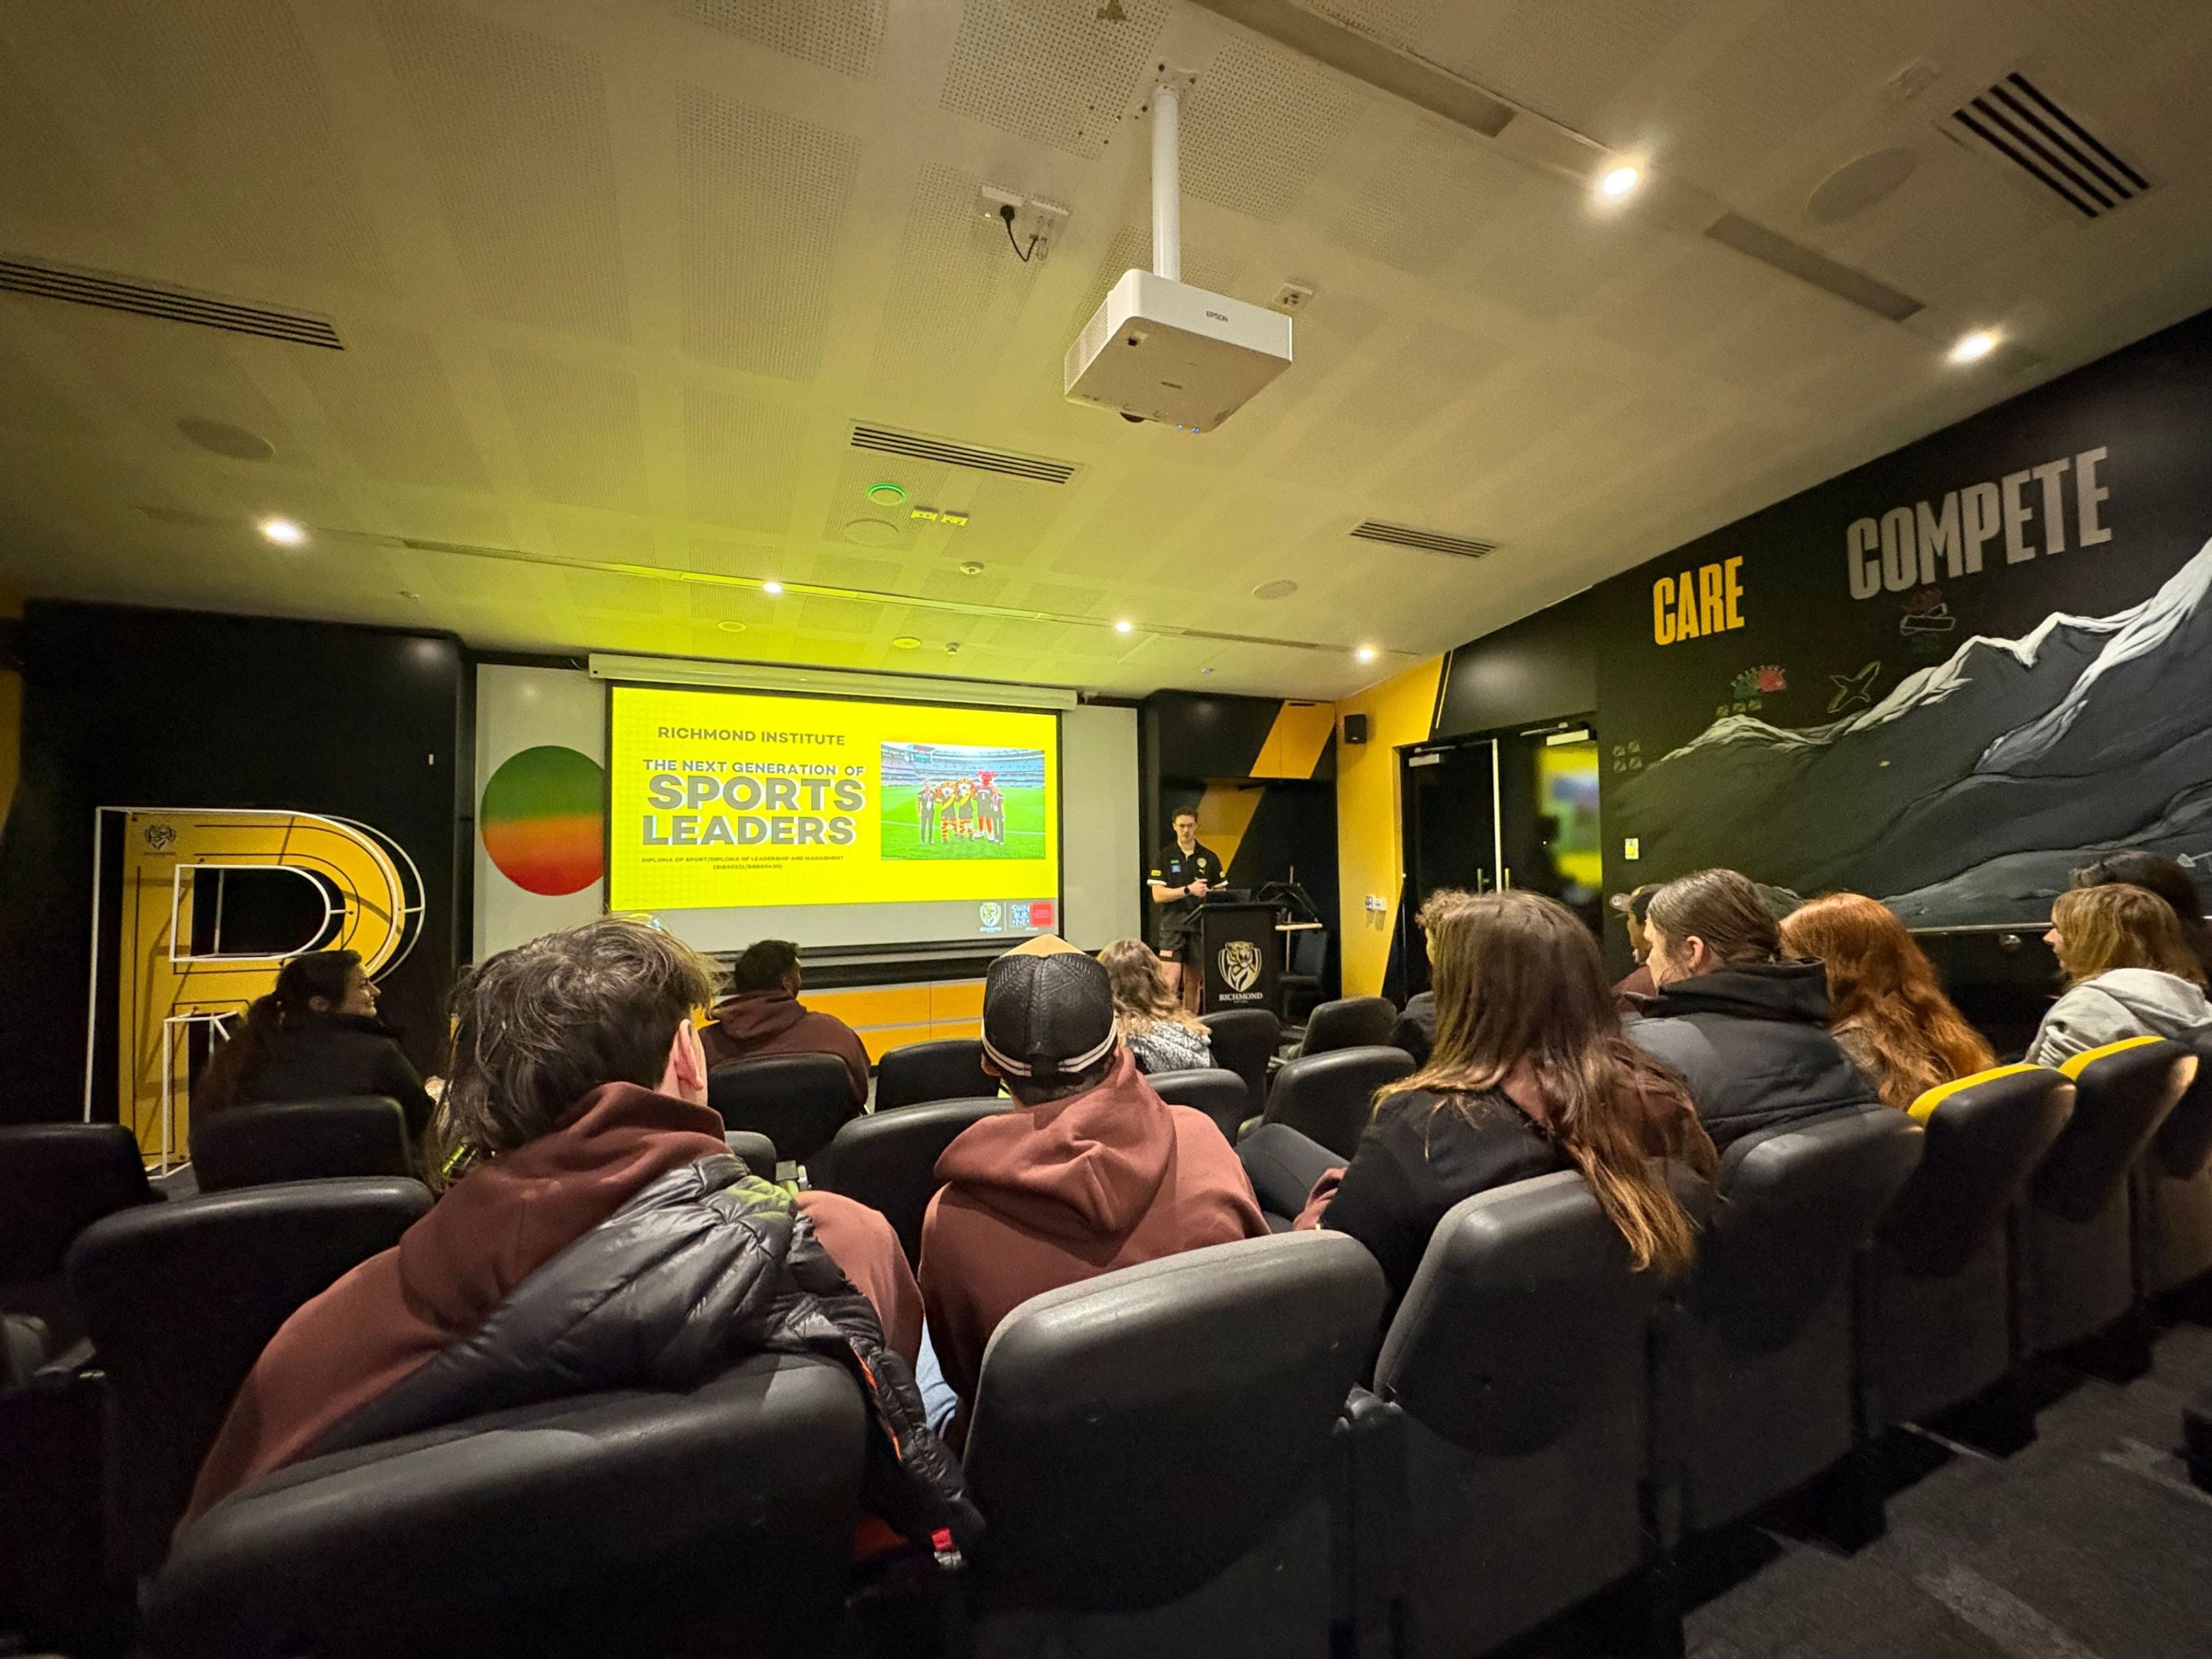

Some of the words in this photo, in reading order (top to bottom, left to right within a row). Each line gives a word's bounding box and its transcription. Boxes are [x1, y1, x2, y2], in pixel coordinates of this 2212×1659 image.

[1206, 310, 1228, 323] EPSON
[1846, 446, 2112, 600] COMPETE
[1653, 556, 1745, 646] CARE
[657, 726, 757, 743] RICHMOND
[761, 730, 846, 747] INSTITUTE
[643, 759, 677, 771] THE
[682, 760, 727, 773] NEXT
[731, 761, 836, 776] GENERATION
[844, 765, 865, 777] OF
[647, 774, 864, 811] SPORTS
[643, 815, 854, 846] LEADERS
[1219, 992, 1263, 1002] RICHMOND
